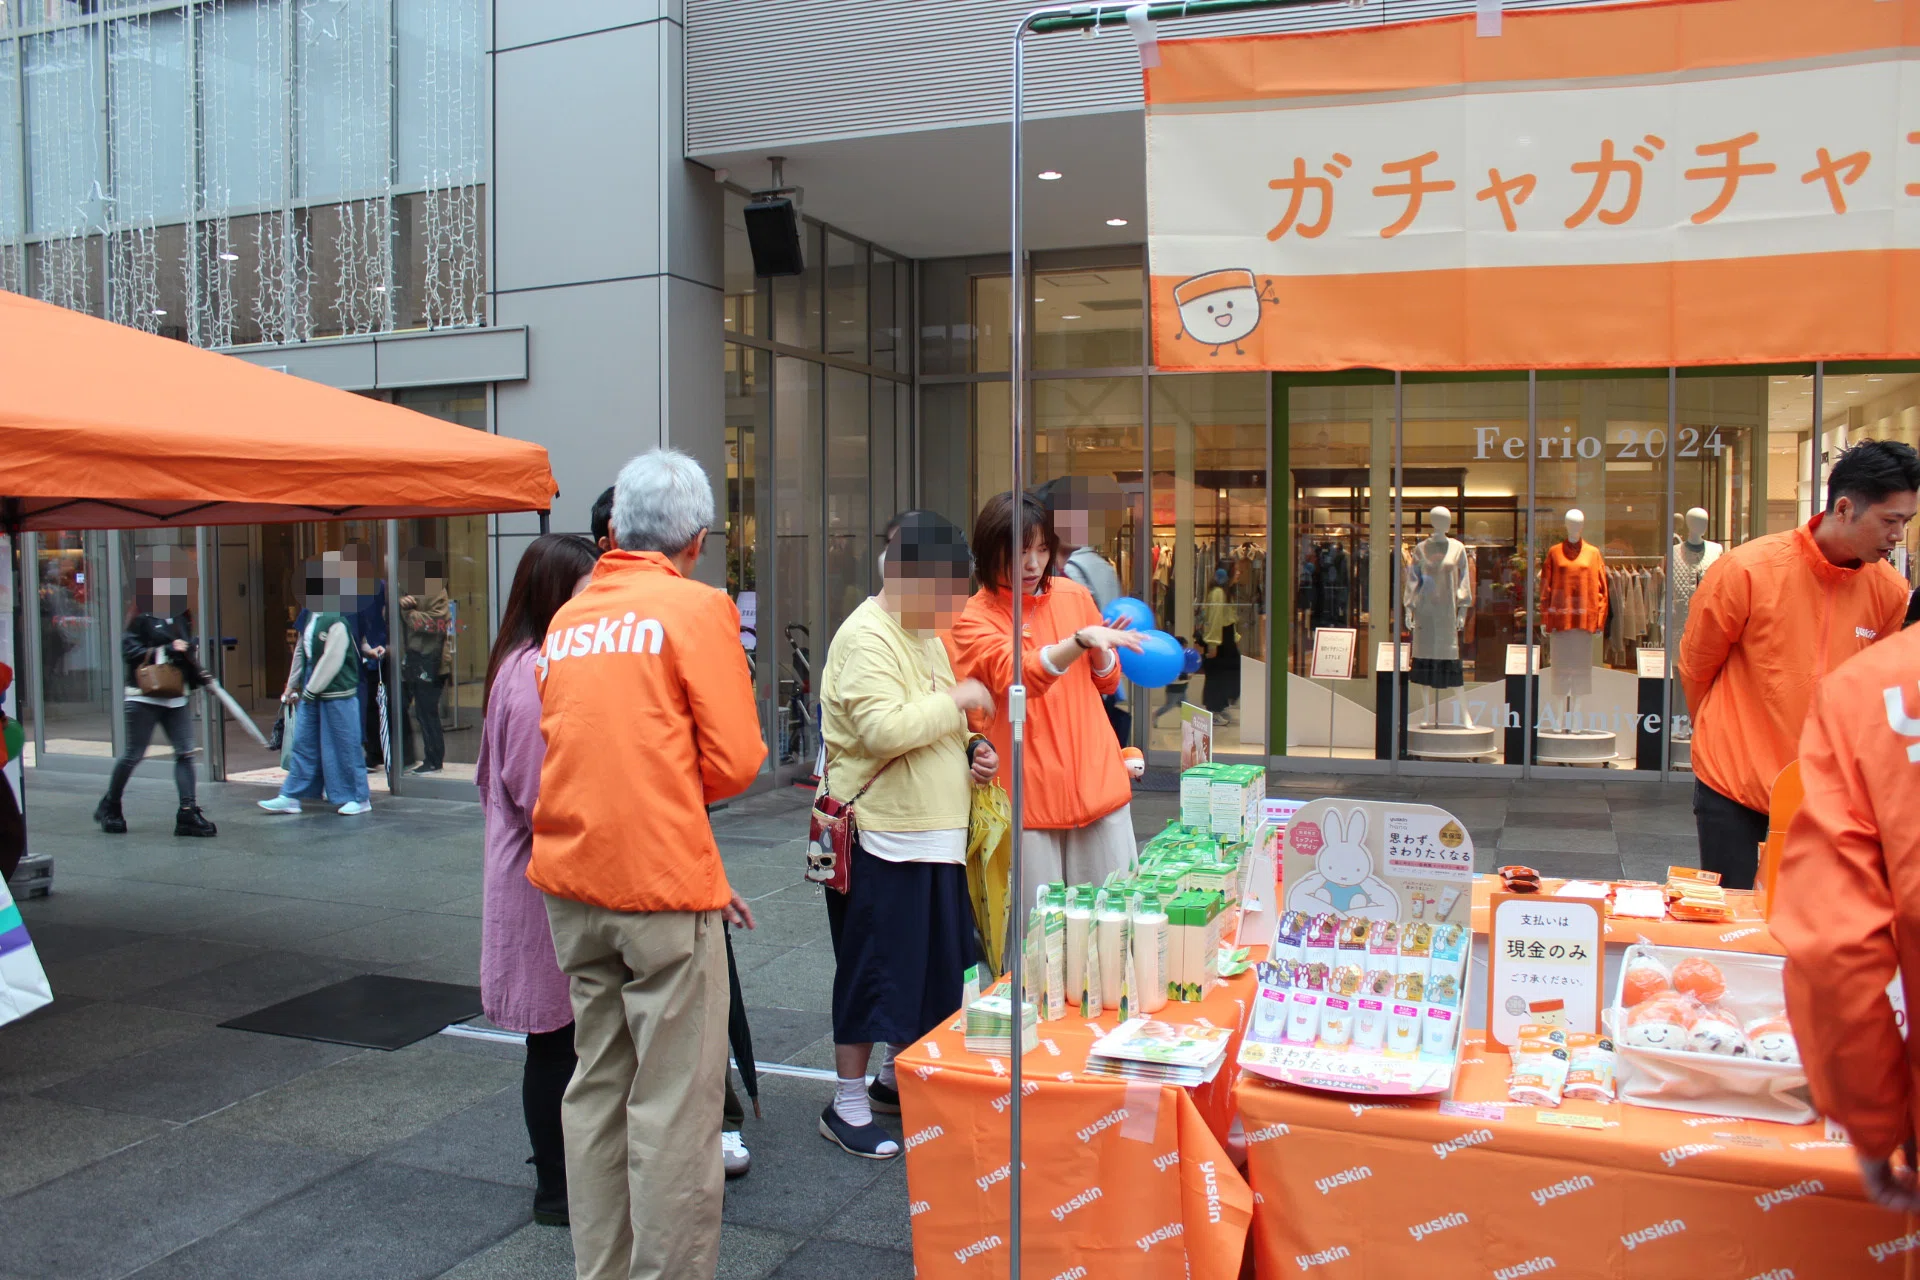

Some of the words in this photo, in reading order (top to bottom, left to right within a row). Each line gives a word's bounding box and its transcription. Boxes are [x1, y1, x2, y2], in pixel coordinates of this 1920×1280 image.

[1473, 426, 1602, 460] Ferio
[1616, 425, 1726, 459] 2024
[1450, 700, 1522, 729] 17th
[1389, 832, 1435, 847] 思わず、
[1389, 846, 1471, 862] さわりたくなる
[1520, 914, 1569, 927] 支払いは
[1506, 939, 1588, 961] 現金のみ
[1510, 973, 1583, 987] ご了承ください。
[990, 1081, 1039, 1113] yuin
[1076, 1106, 1129, 1143] yuskin
[1245, 1123, 1291, 1147] yuskin
[1432, 1128, 1494, 1160] yuskin
[1153, 1149, 1180, 1172] yus
[976, 1161, 1026, 1192] yusk
[1315, 1166, 1372, 1195] yuskin
[1531, 1175, 1594, 1206] yuskin
[1051, 1186, 1103, 1222] yuskin
[1199, 1160, 1223, 1224] yuskin
[1754, 1179, 1824, 1212] yuskin
[1136, 1221, 1184, 1252] yuskin
[1408, 1212, 1469, 1242] yuskin
[1620, 1218, 1686, 1250] yuskin
[954, 1235, 1002, 1264] yuskin
[1295, 1244, 1351, 1271] yuskin
